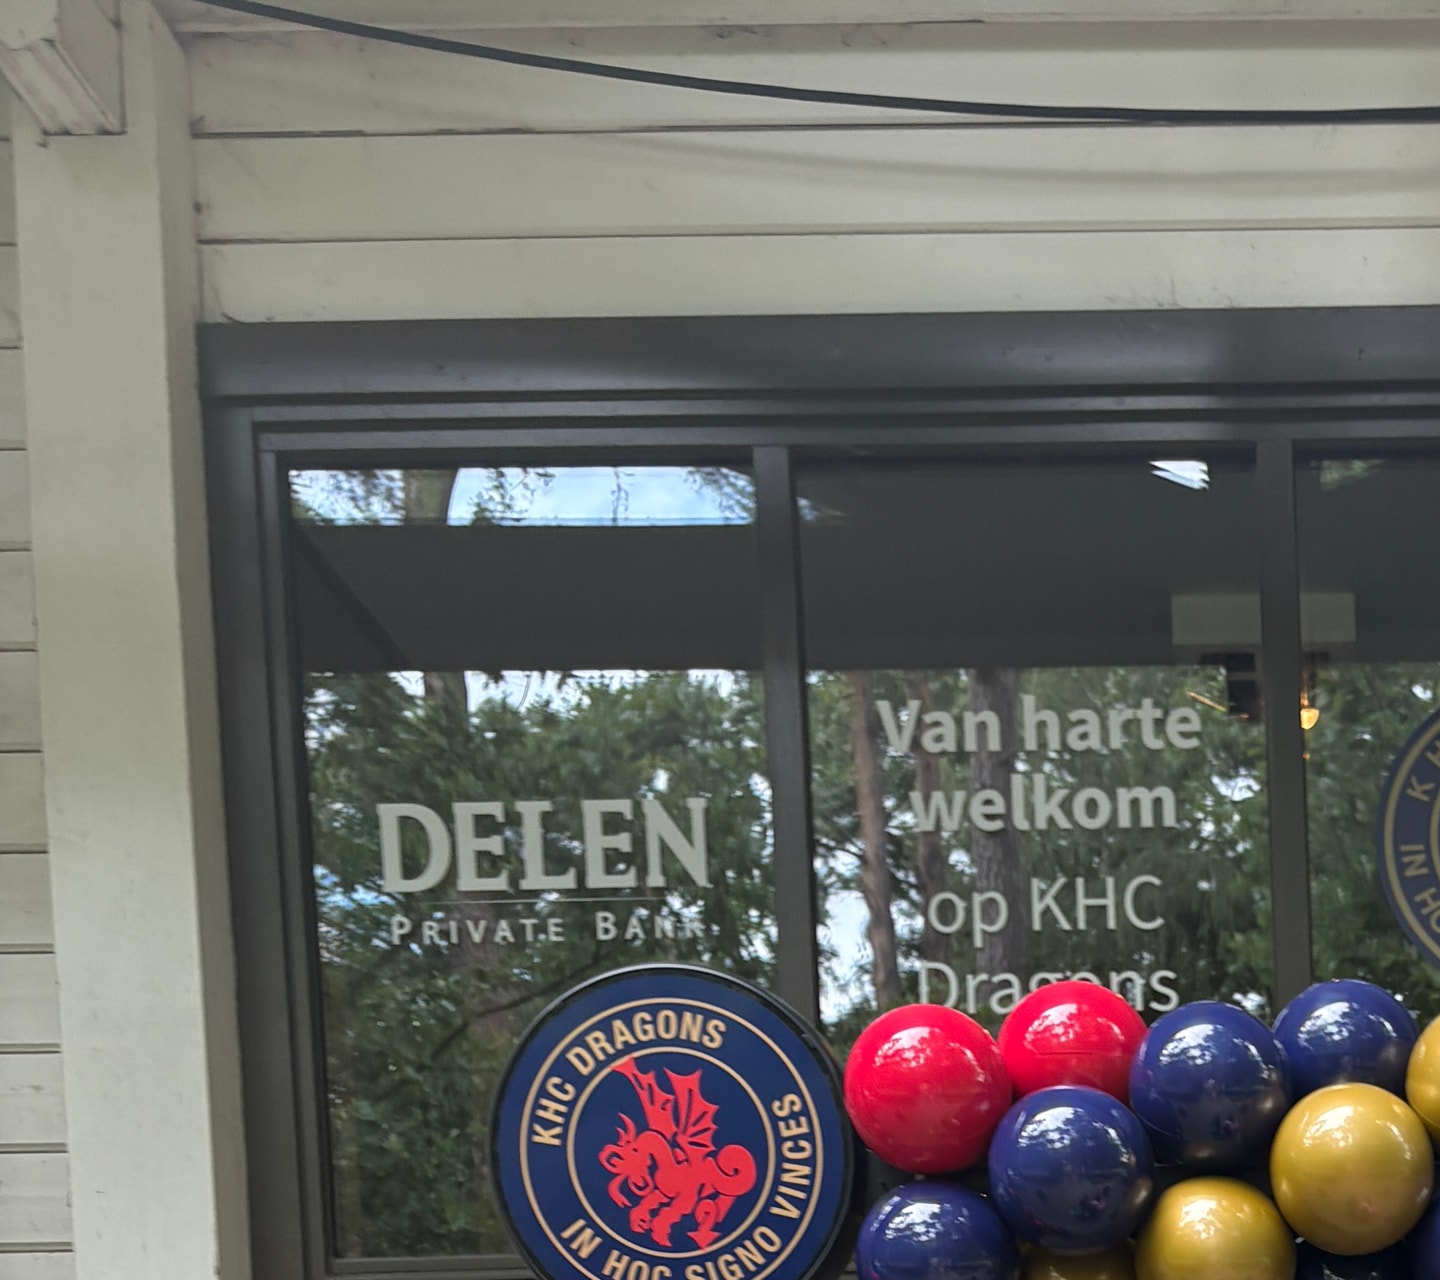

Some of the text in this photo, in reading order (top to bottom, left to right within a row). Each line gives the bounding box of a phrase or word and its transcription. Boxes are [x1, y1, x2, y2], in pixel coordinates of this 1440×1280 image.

[876, 695, 1200, 754] Van harte
[909, 773, 1178, 832] welkom
[376, 797, 712, 893] DELEN
[1401, 844, 1429, 878] IN
[391, 910, 705, 946] PRIVATE BANK
[927, 874, 1165, 949] op KHC
[918, 960, 1180, 1014] Drans
[531, 1009, 727, 1147] KHC DRAGONS
[560, 1218, 603, 1259] IN
[769, 1092, 812, 1220] VINCES
